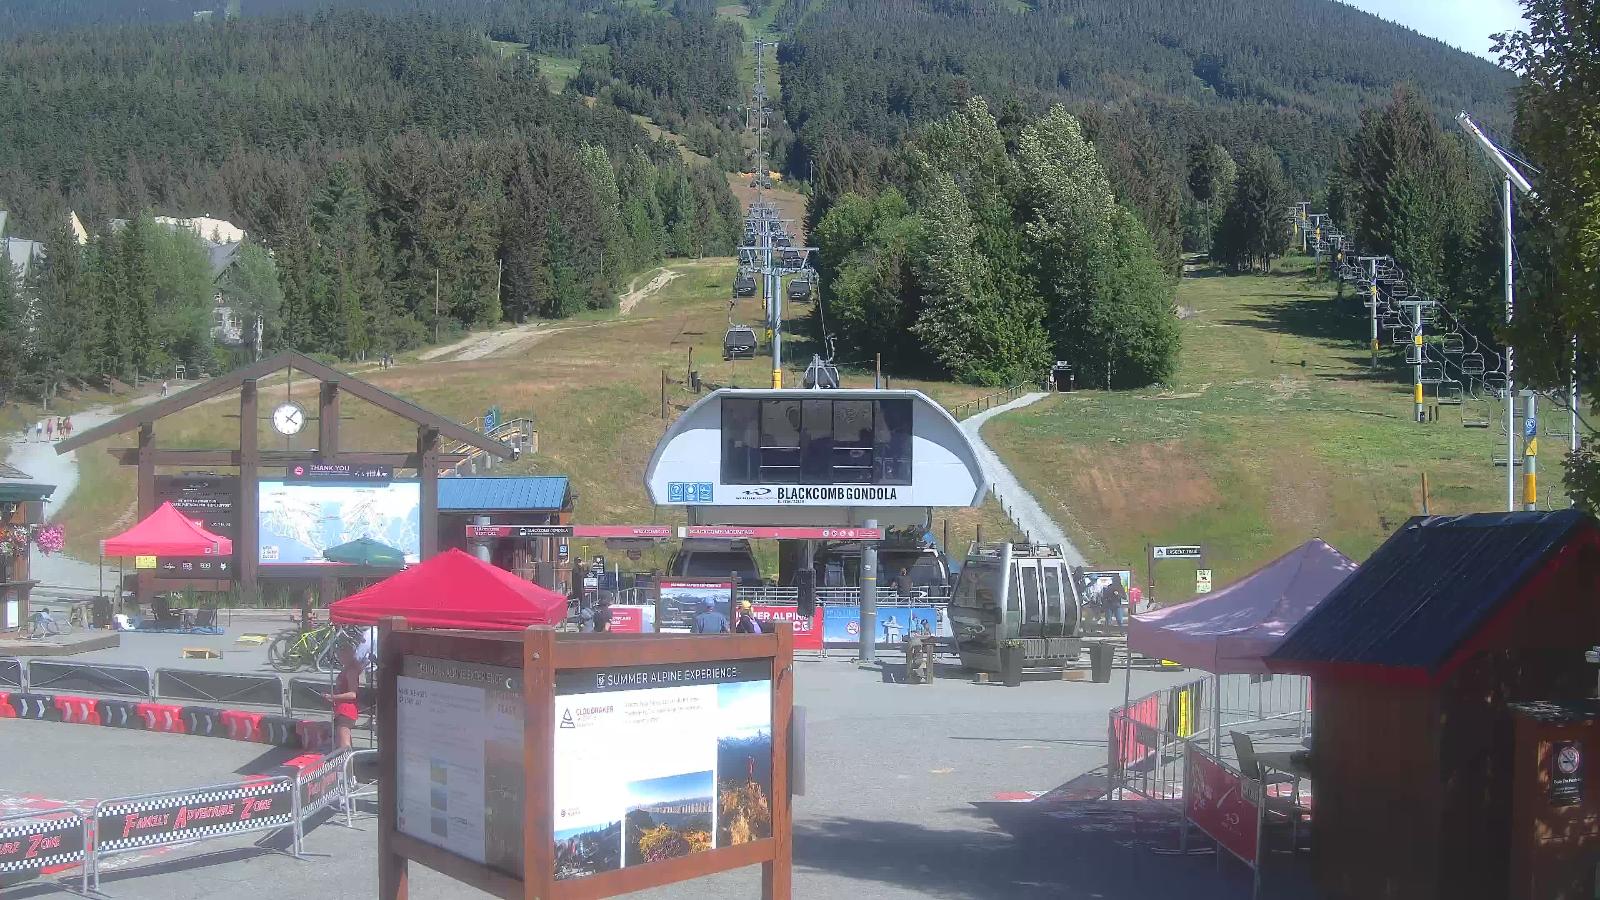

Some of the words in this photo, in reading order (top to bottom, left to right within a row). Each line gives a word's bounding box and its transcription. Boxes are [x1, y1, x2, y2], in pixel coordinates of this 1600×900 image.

[777, 487, 845, 500] BLACKCOMB
[846, 487, 897, 500] GONDOLA
[607, 672, 648, 686] SUMMER
[650, 670, 682, 682] ALPINE
[684, 667, 737, 680] EXPERIENCE
[122, 812, 170, 838] FAMILY
[173, 803, 236, 831] ADVENTURE
[240, 796, 273, 820] ZONE
[25, 833, 62, 859] ZONE
